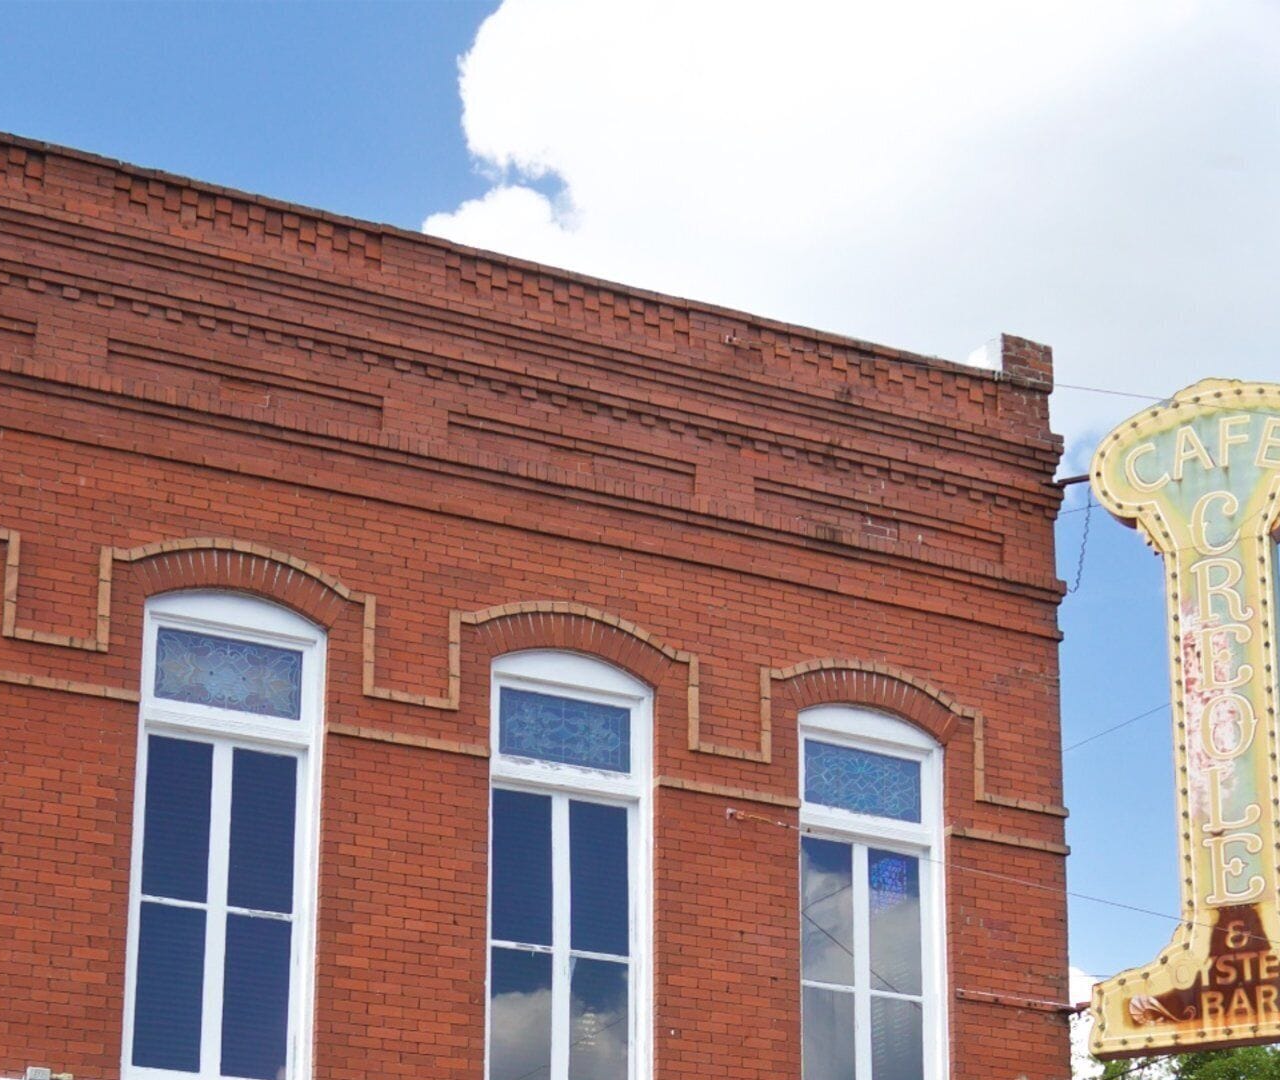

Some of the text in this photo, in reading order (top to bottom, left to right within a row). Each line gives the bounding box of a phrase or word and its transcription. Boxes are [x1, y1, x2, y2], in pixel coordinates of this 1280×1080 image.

[1189, 490, 1266, 906] CREOLE
[1225, 920, 1250, 949] &
[1201, 986, 1278, 1019] BAR
